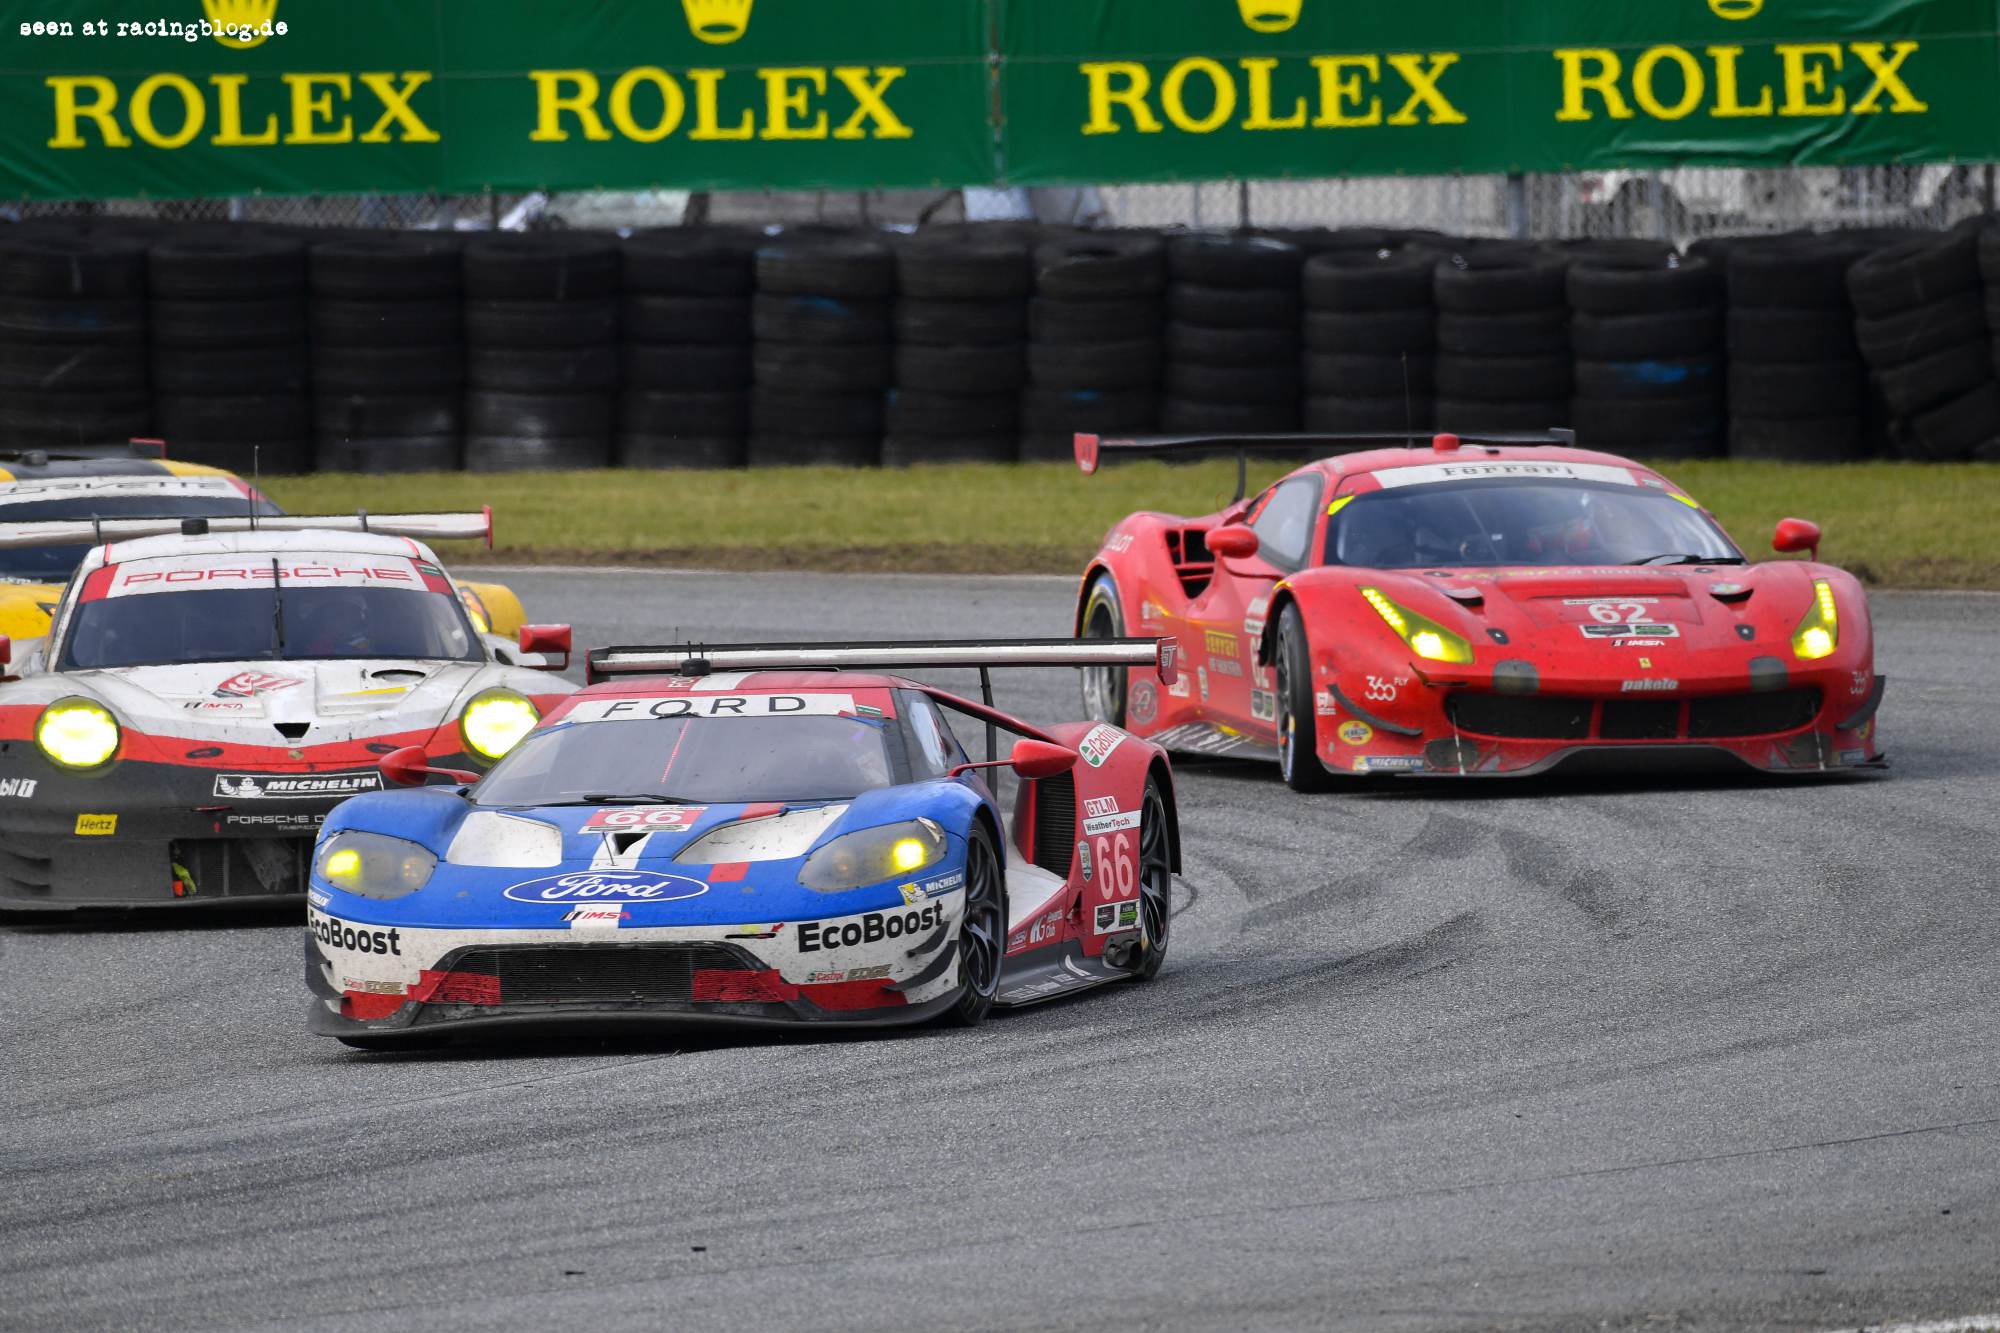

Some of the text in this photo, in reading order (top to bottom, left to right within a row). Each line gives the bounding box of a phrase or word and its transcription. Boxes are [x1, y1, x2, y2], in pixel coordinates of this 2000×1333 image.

[1554, 42, 1927, 121] ROLEX
[1081, 53, 1467, 134] ROLEX
[47, 73, 440, 148] ROLEX
[530, 67, 912, 142] ROLEX
[123, 566, 413, 587] PORSCHE
[1588, 603, 1654, 625] 62
[601, 695, 806, 719] FORD
[266, 777, 377, 791] MICHELIN
[1086, 796, 1117, 816] GTLM
[79, 820, 113, 831] Hertz
[226, 814, 310, 825] PORSCHE
[604, 810, 683, 826] 66
[1086, 817, 1131, 832] WeatherTech
[1096, 832, 1134, 901] 66
[541, 873, 671, 899] Ford
[925, 873, 964, 893] MICHELIN
[573, 911, 632, 920] IMSA
[798, 900, 944, 953] EcoBoost
[848, 964, 893, 979] EDGE
